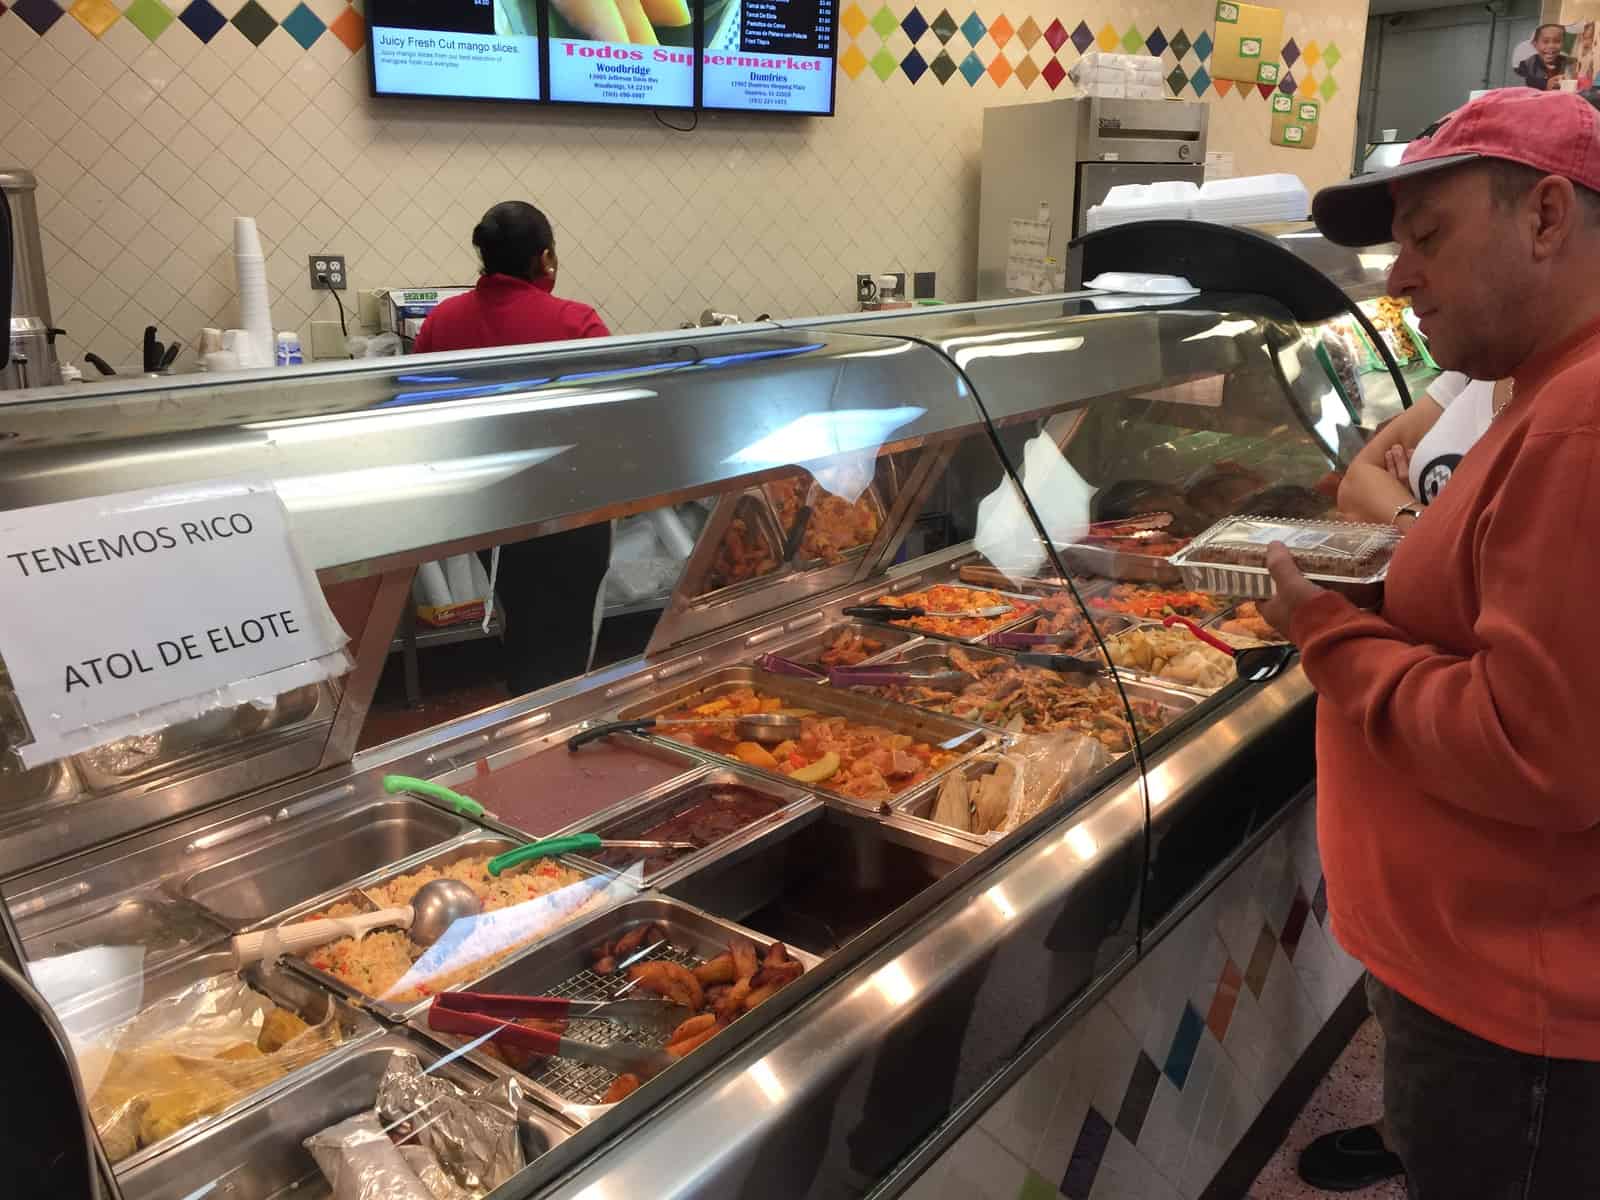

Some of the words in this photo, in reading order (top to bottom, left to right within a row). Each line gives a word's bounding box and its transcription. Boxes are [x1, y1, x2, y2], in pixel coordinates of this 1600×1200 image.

[379, 34, 405, 48] Juicy
[407, 36, 436, 49] Fresh
[438, 38, 455, 50] Cut
[457, 41, 490, 54] mango
[561, 43, 643, 61] Todos
[596, 63, 651, 75] Woodbridge
[750, 72, 788, 83] Dumfries
[8, 527, 177, 577] TENEMOS
[181, 513, 253, 544] RICO
[65, 650, 153, 693] ATOL
[157, 635, 202, 666] DE
[207, 610, 299, 653] ELOTE
